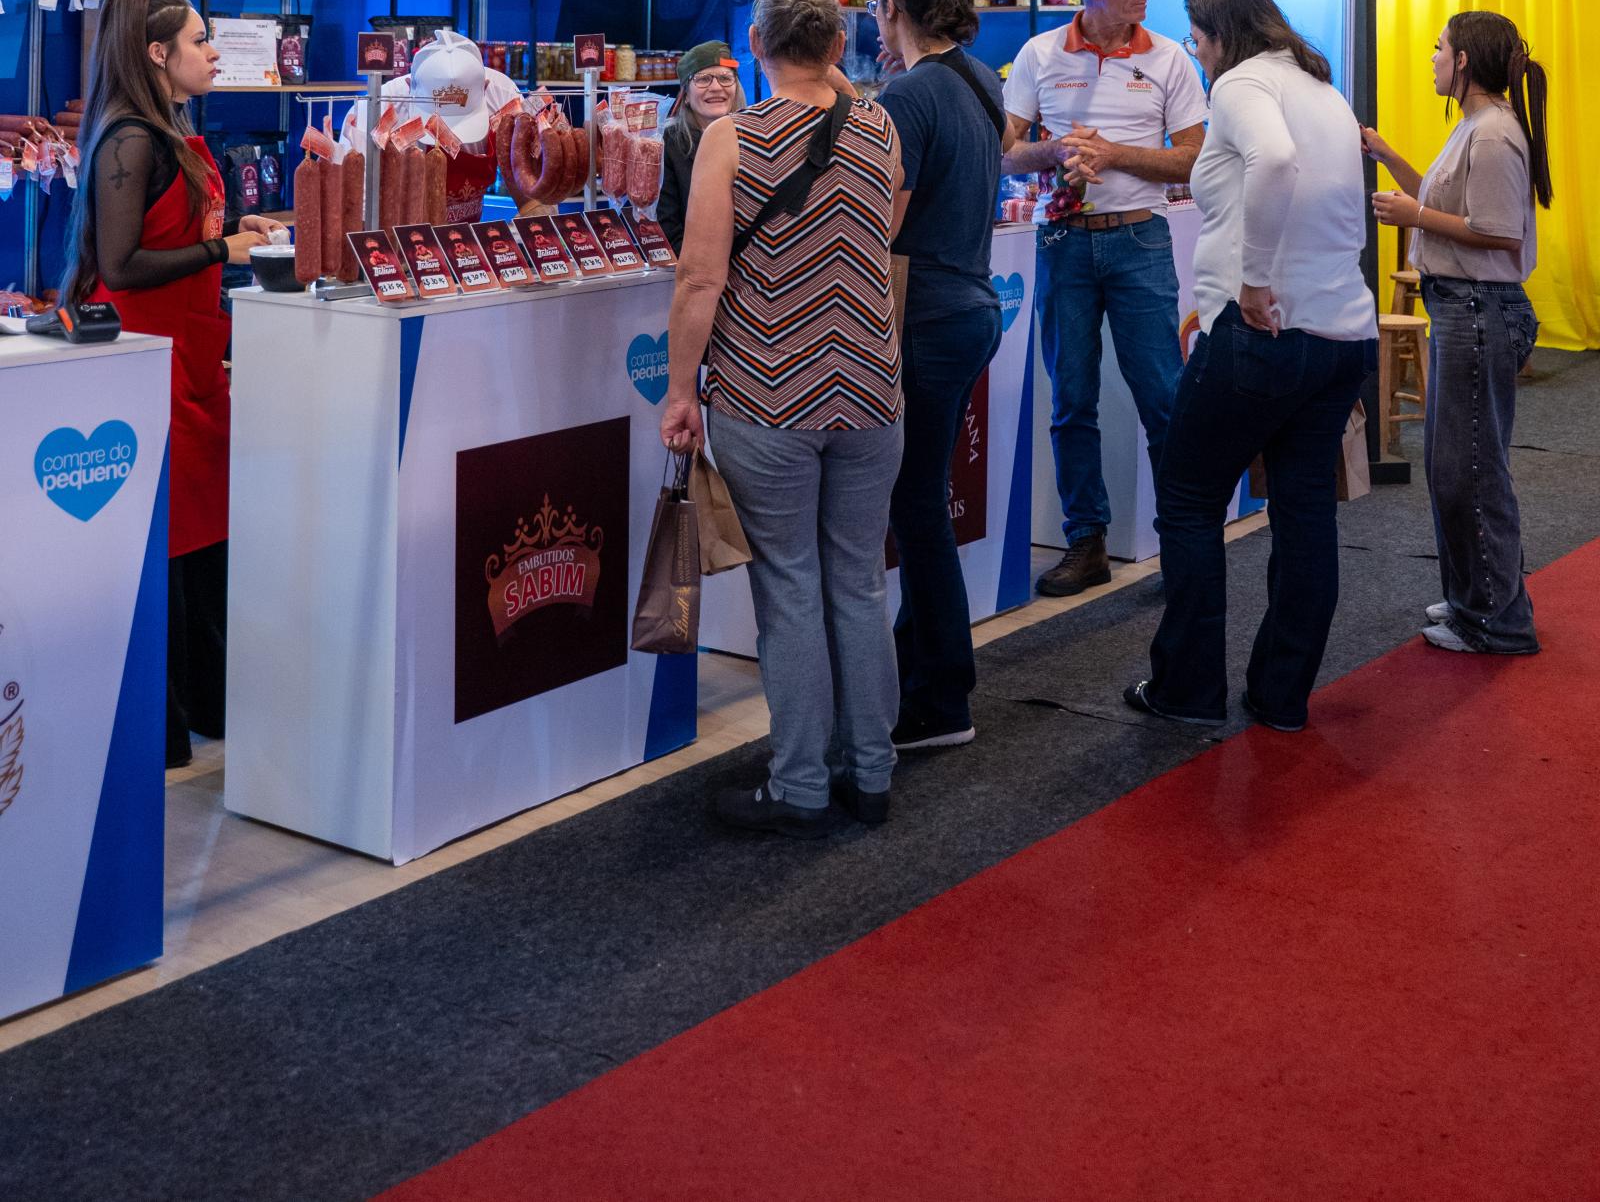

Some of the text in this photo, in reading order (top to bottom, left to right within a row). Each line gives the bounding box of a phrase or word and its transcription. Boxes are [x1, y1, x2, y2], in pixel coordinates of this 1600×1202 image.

[999, 298, 1022, 314] queno
[631, 350, 667, 367] compre
[631, 363, 670, 381] peque
[42, 441, 131, 473] compre do
[42, 461, 131, 491] pequeno
[518, 548, 575, 575] EMBUTIDOS
[504, 563, 586, 617] SABIM
[674, 597, 690, 640] Lindt
